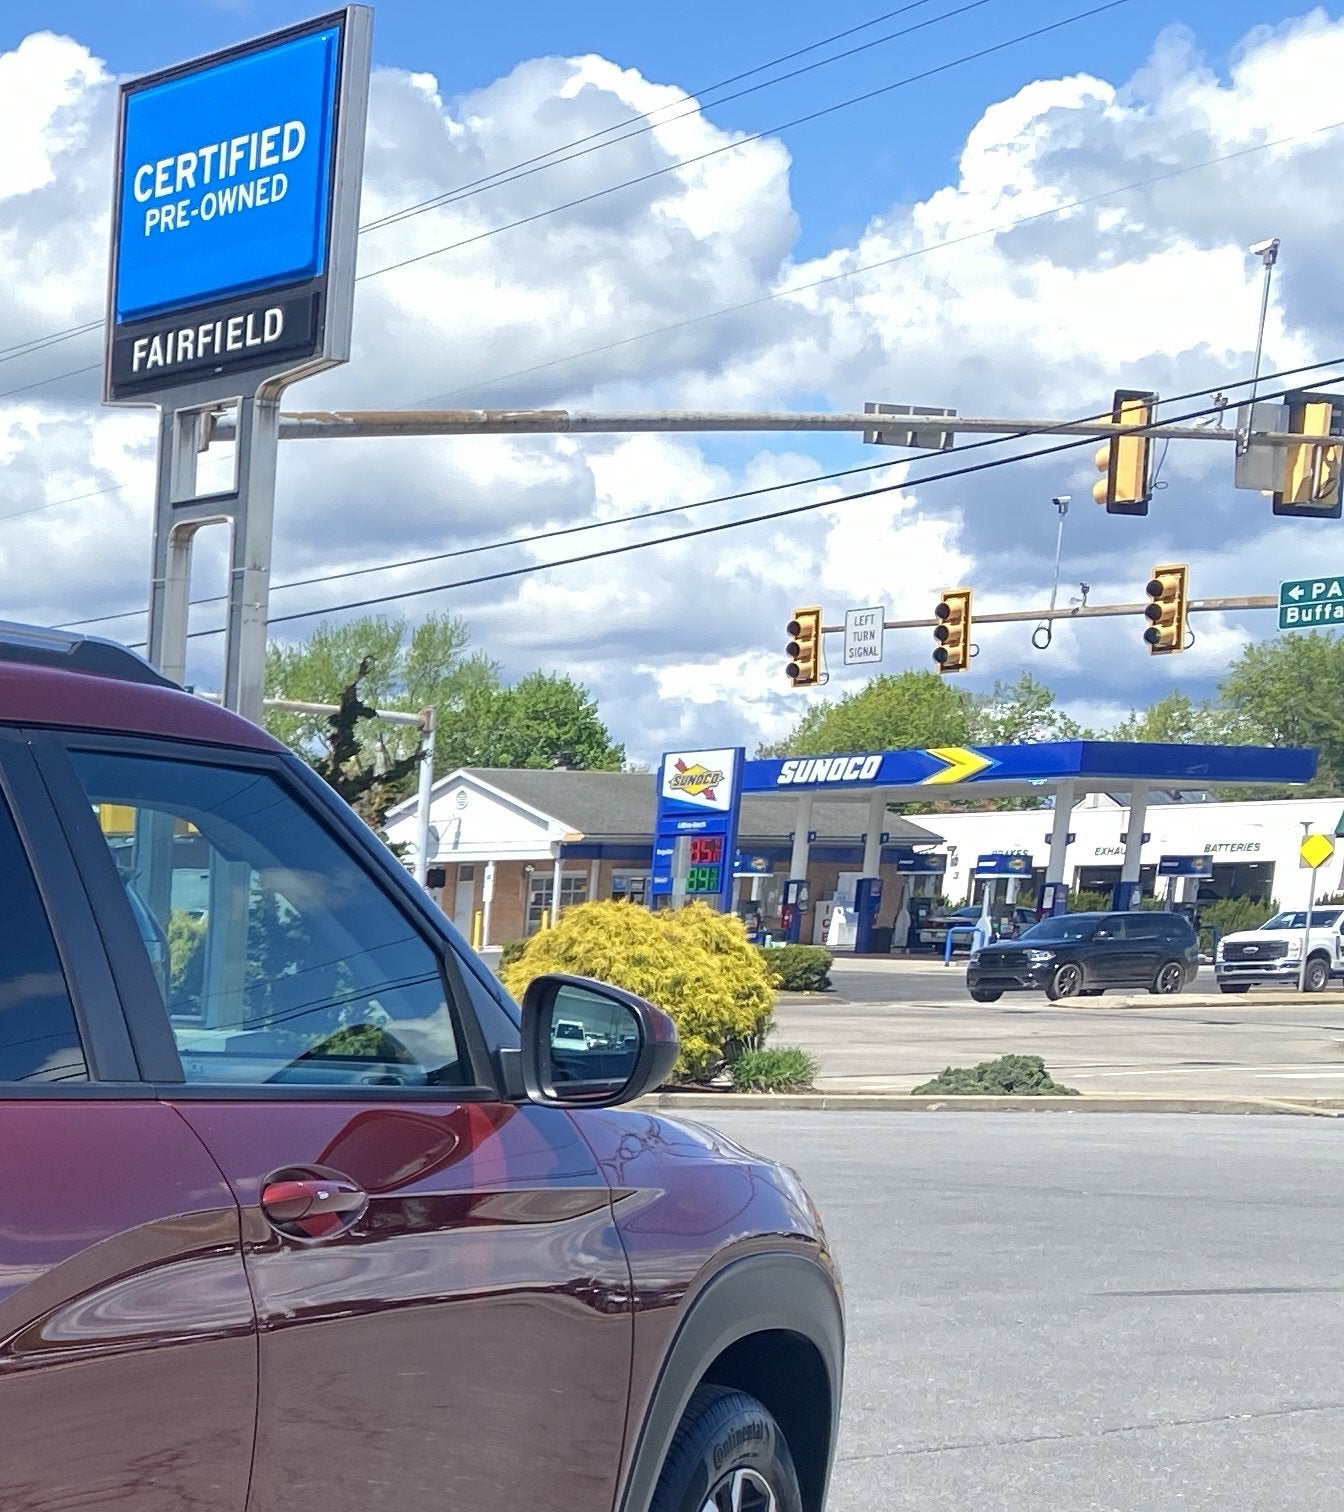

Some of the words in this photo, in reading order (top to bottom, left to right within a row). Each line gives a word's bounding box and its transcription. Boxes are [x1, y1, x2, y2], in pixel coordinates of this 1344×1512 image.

[133, 120, 306, 203] CERTIFIED
[145, 173, 288, 237] PRE-OWNED
[132, 308, 285, 373] FAIRFIELD
[1312, 580, 1343, 599] PA
[854, 614, 875, 627] LEFT
[853, 630, 875, 642] TURN
[848, 645, 879, 659] SIGNAL
[777, 755, 883, 785] SUNOCO
[672, 773, 721, 787] SUNOCO
[1094, 847, 1127, 856] EXHAU
[1203, 842, 1261, 853] BATTERIES
[713, 1419, 765, 1471] Continental
